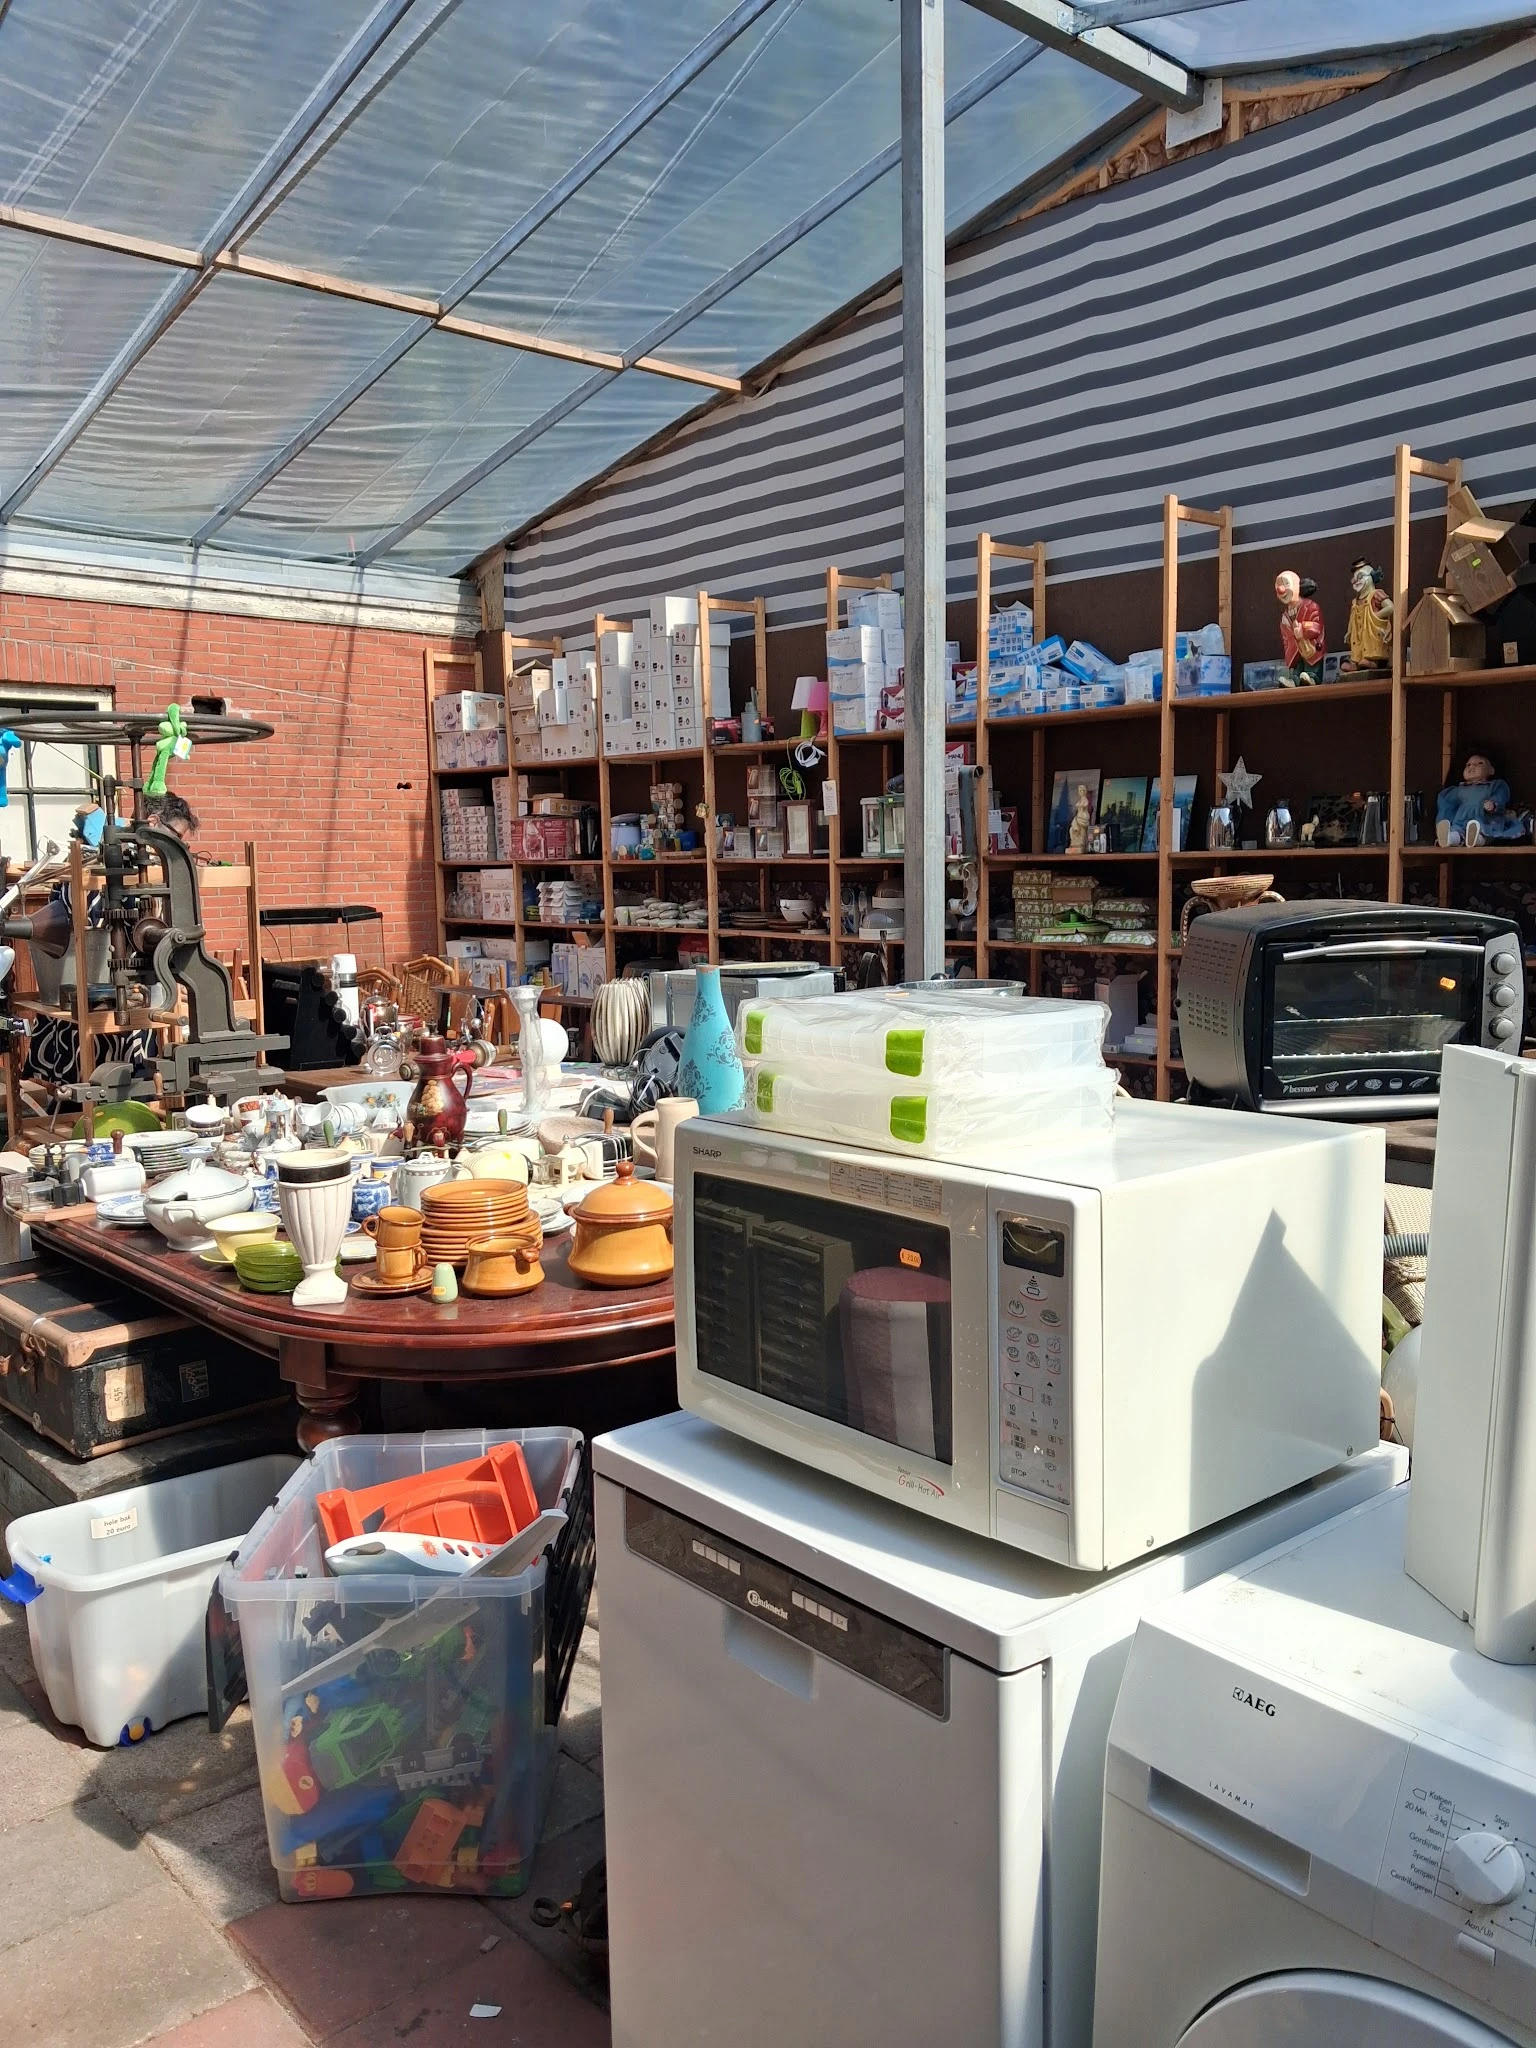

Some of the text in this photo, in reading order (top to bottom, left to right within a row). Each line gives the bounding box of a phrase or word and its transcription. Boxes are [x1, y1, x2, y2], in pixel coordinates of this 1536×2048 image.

[693, 1146, 722, 1158] SHARP
[1011, 1467, 1027, 1477] STOP
[120, 1514, 131, 1522] bak
[106, 1525, 131, 1536] 20 euro
[747, 1590, 788, 1620] Bauknecht
[1243, 1693, 1276, 1717] AEG
[1209, 1781, 1254, 1809] LAVAMAT
[1429, 1791, 1453, 1806] Katoen
[1405, 1801, 1415, 1811] 20
[1415, 1805, 1429, 1818] Min.
[1434, 1814, 1439, 1822] 3
[1440, 1816, 1448, 1828] kg
[1439, 1802, 1450, 1814] Eco
[1494, 1814, 1510, 1828] Stop
[1426, 1825, 1445, 1839] Jeans
[1409, 1832, 1443, 1852] Gordijnen
[1413, 1849, 1439, 1867] Spoelen
[1410, 1863, 1436, 1881] Pompen
[1390, 1869, 1433, 1895] Centrifugeren
[1465, 1918, 1494, 1939] Aan/Uit
